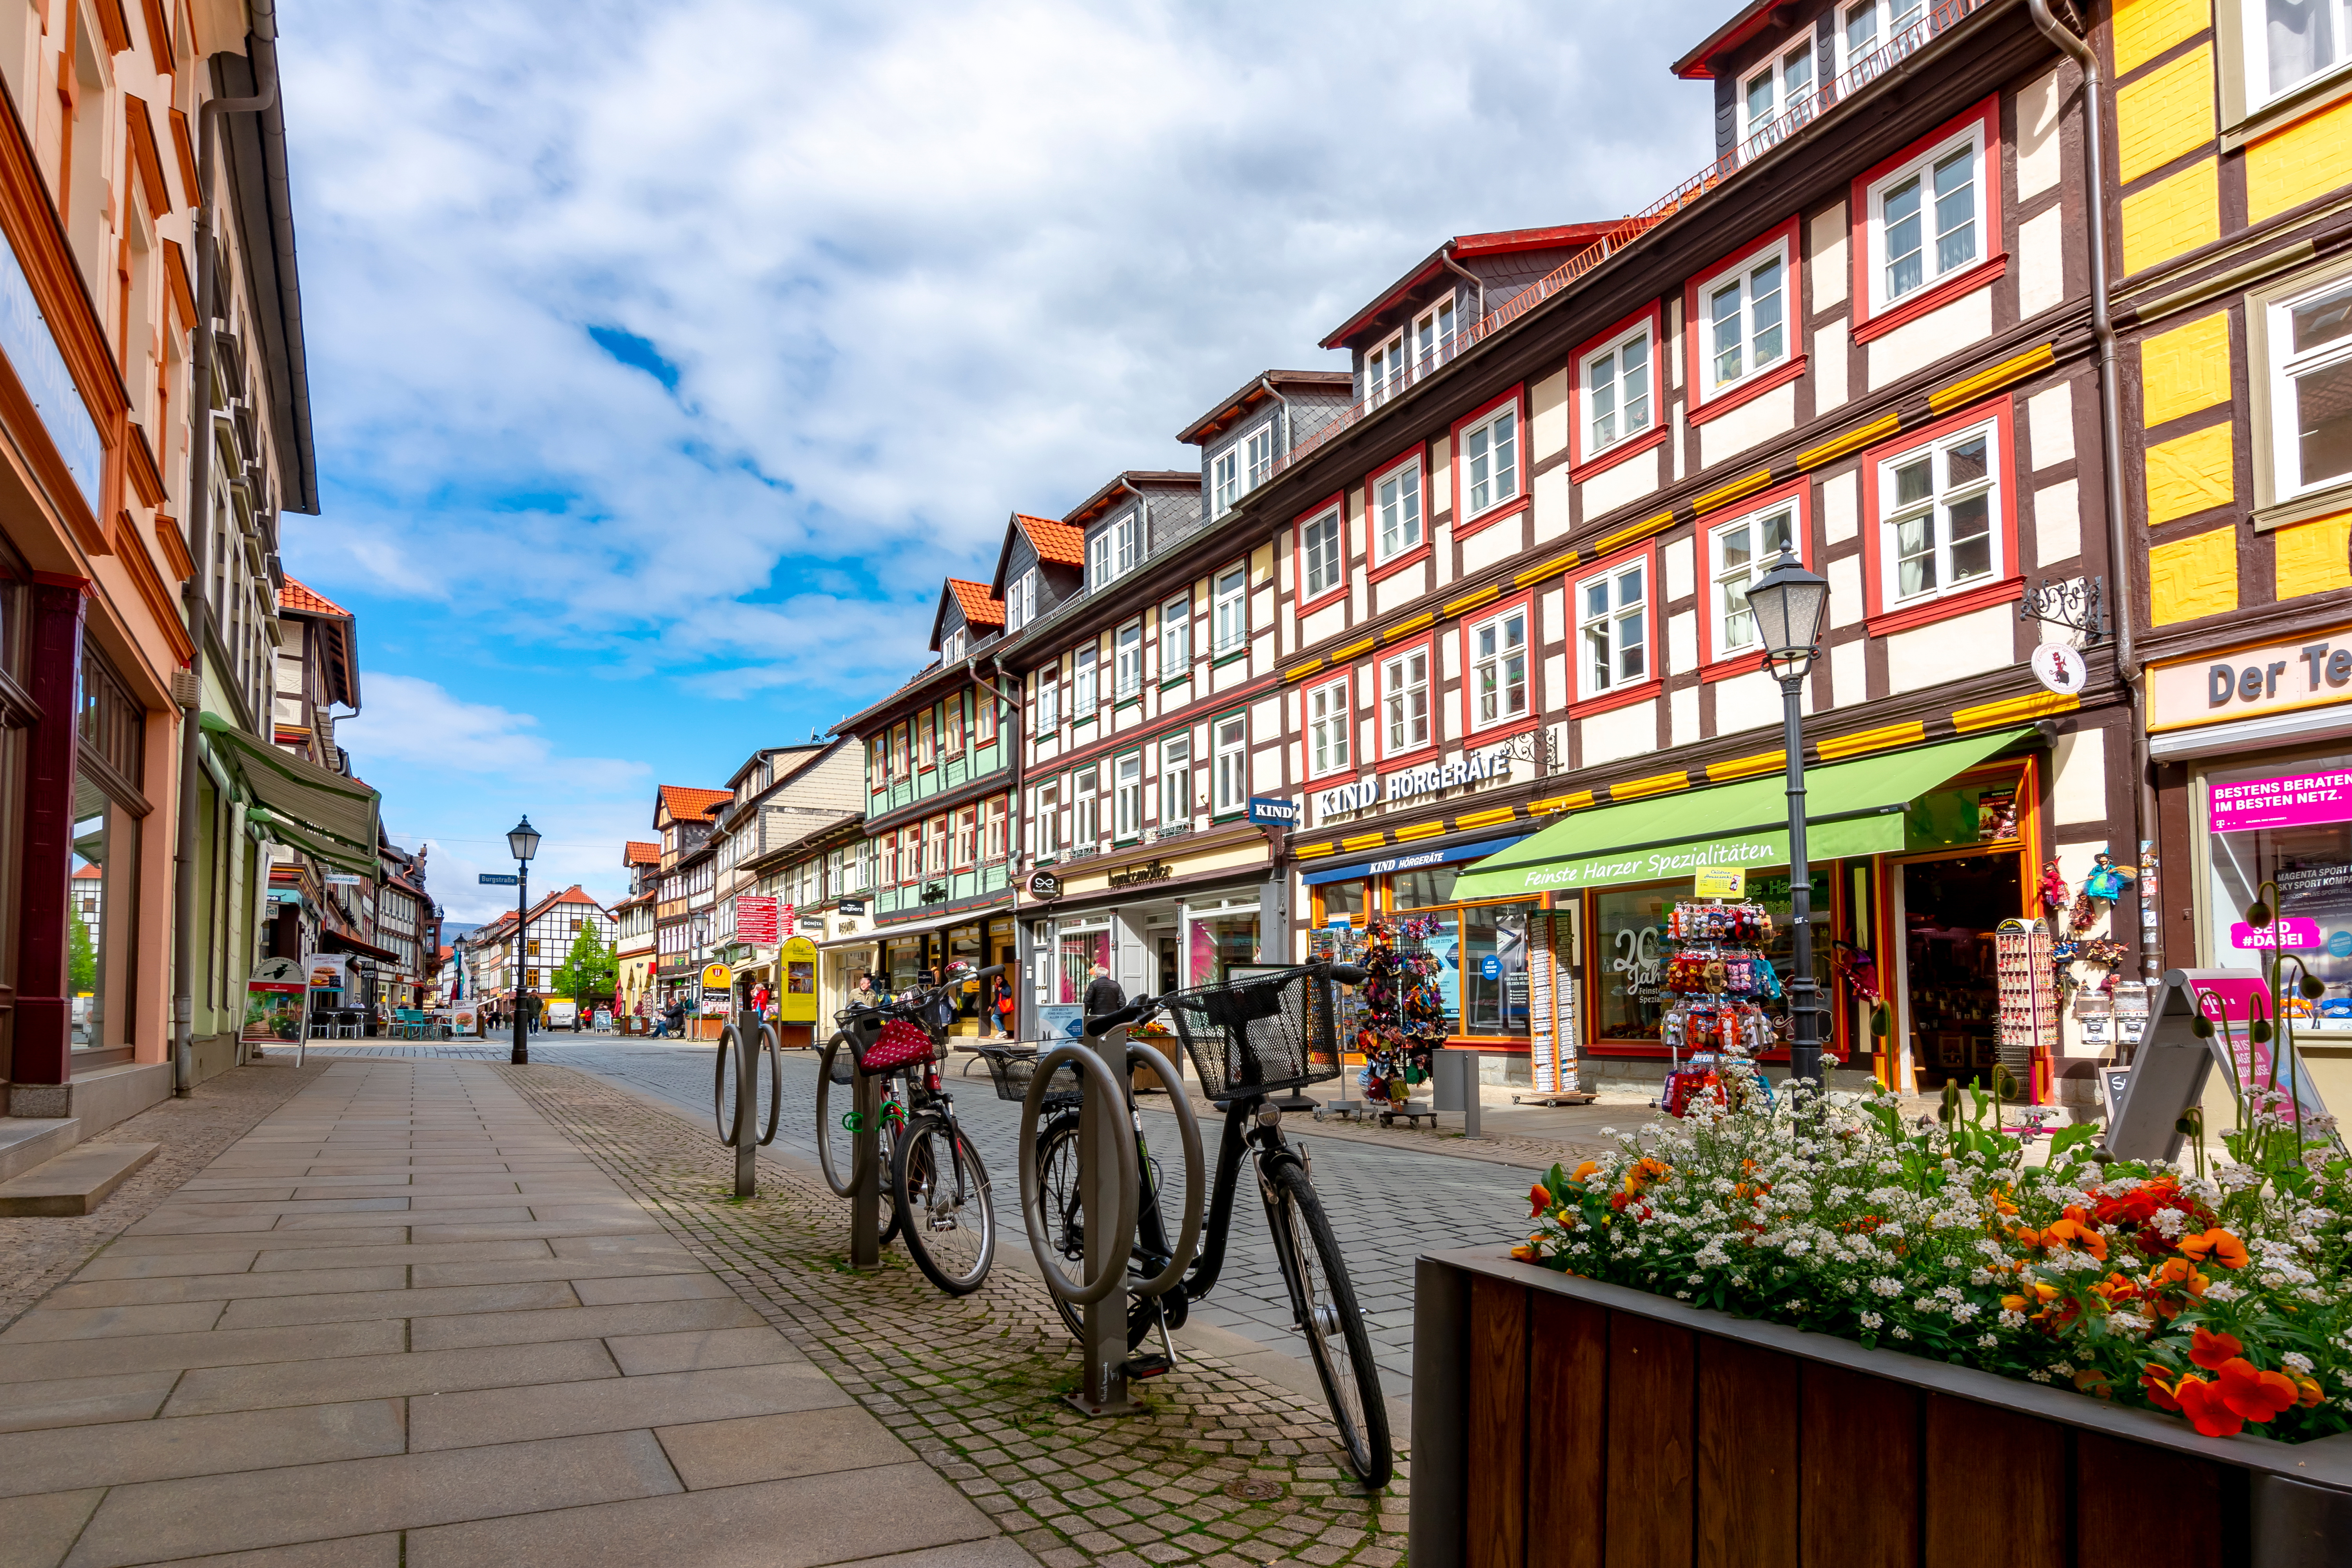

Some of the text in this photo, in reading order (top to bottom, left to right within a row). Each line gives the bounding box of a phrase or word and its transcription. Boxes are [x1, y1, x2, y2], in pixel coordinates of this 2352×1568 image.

[2210, 642, 2352, 703] Der Te
[1318, 750, 1510, 819] KIND HÖRGERÄTE
[2215, 773, 2352, 799] BESTENS BERATEN
[1255, 804, 1293, 819] KIND
[2215, 789, 2343, 812] IM BESTEN NETZ.
[1369, 852, 1445, 874] KIND HÖRGERÄTE
[1524, 842, 1775, 887] Feinste Harzer Spezialitäten
[2278, 866, 2349, 881] MAGENTA SPORT
[2278, 875, 2352, 891] SKY SPORT KOMPA
[2252, 921, 2291, 935] SED
[252, 958, 305, 981] HEXLICH WILLKOMMEN
[2222, 1040, 2241, 1051] HER
[2234, 1052, 2265, 1065] AGETA
